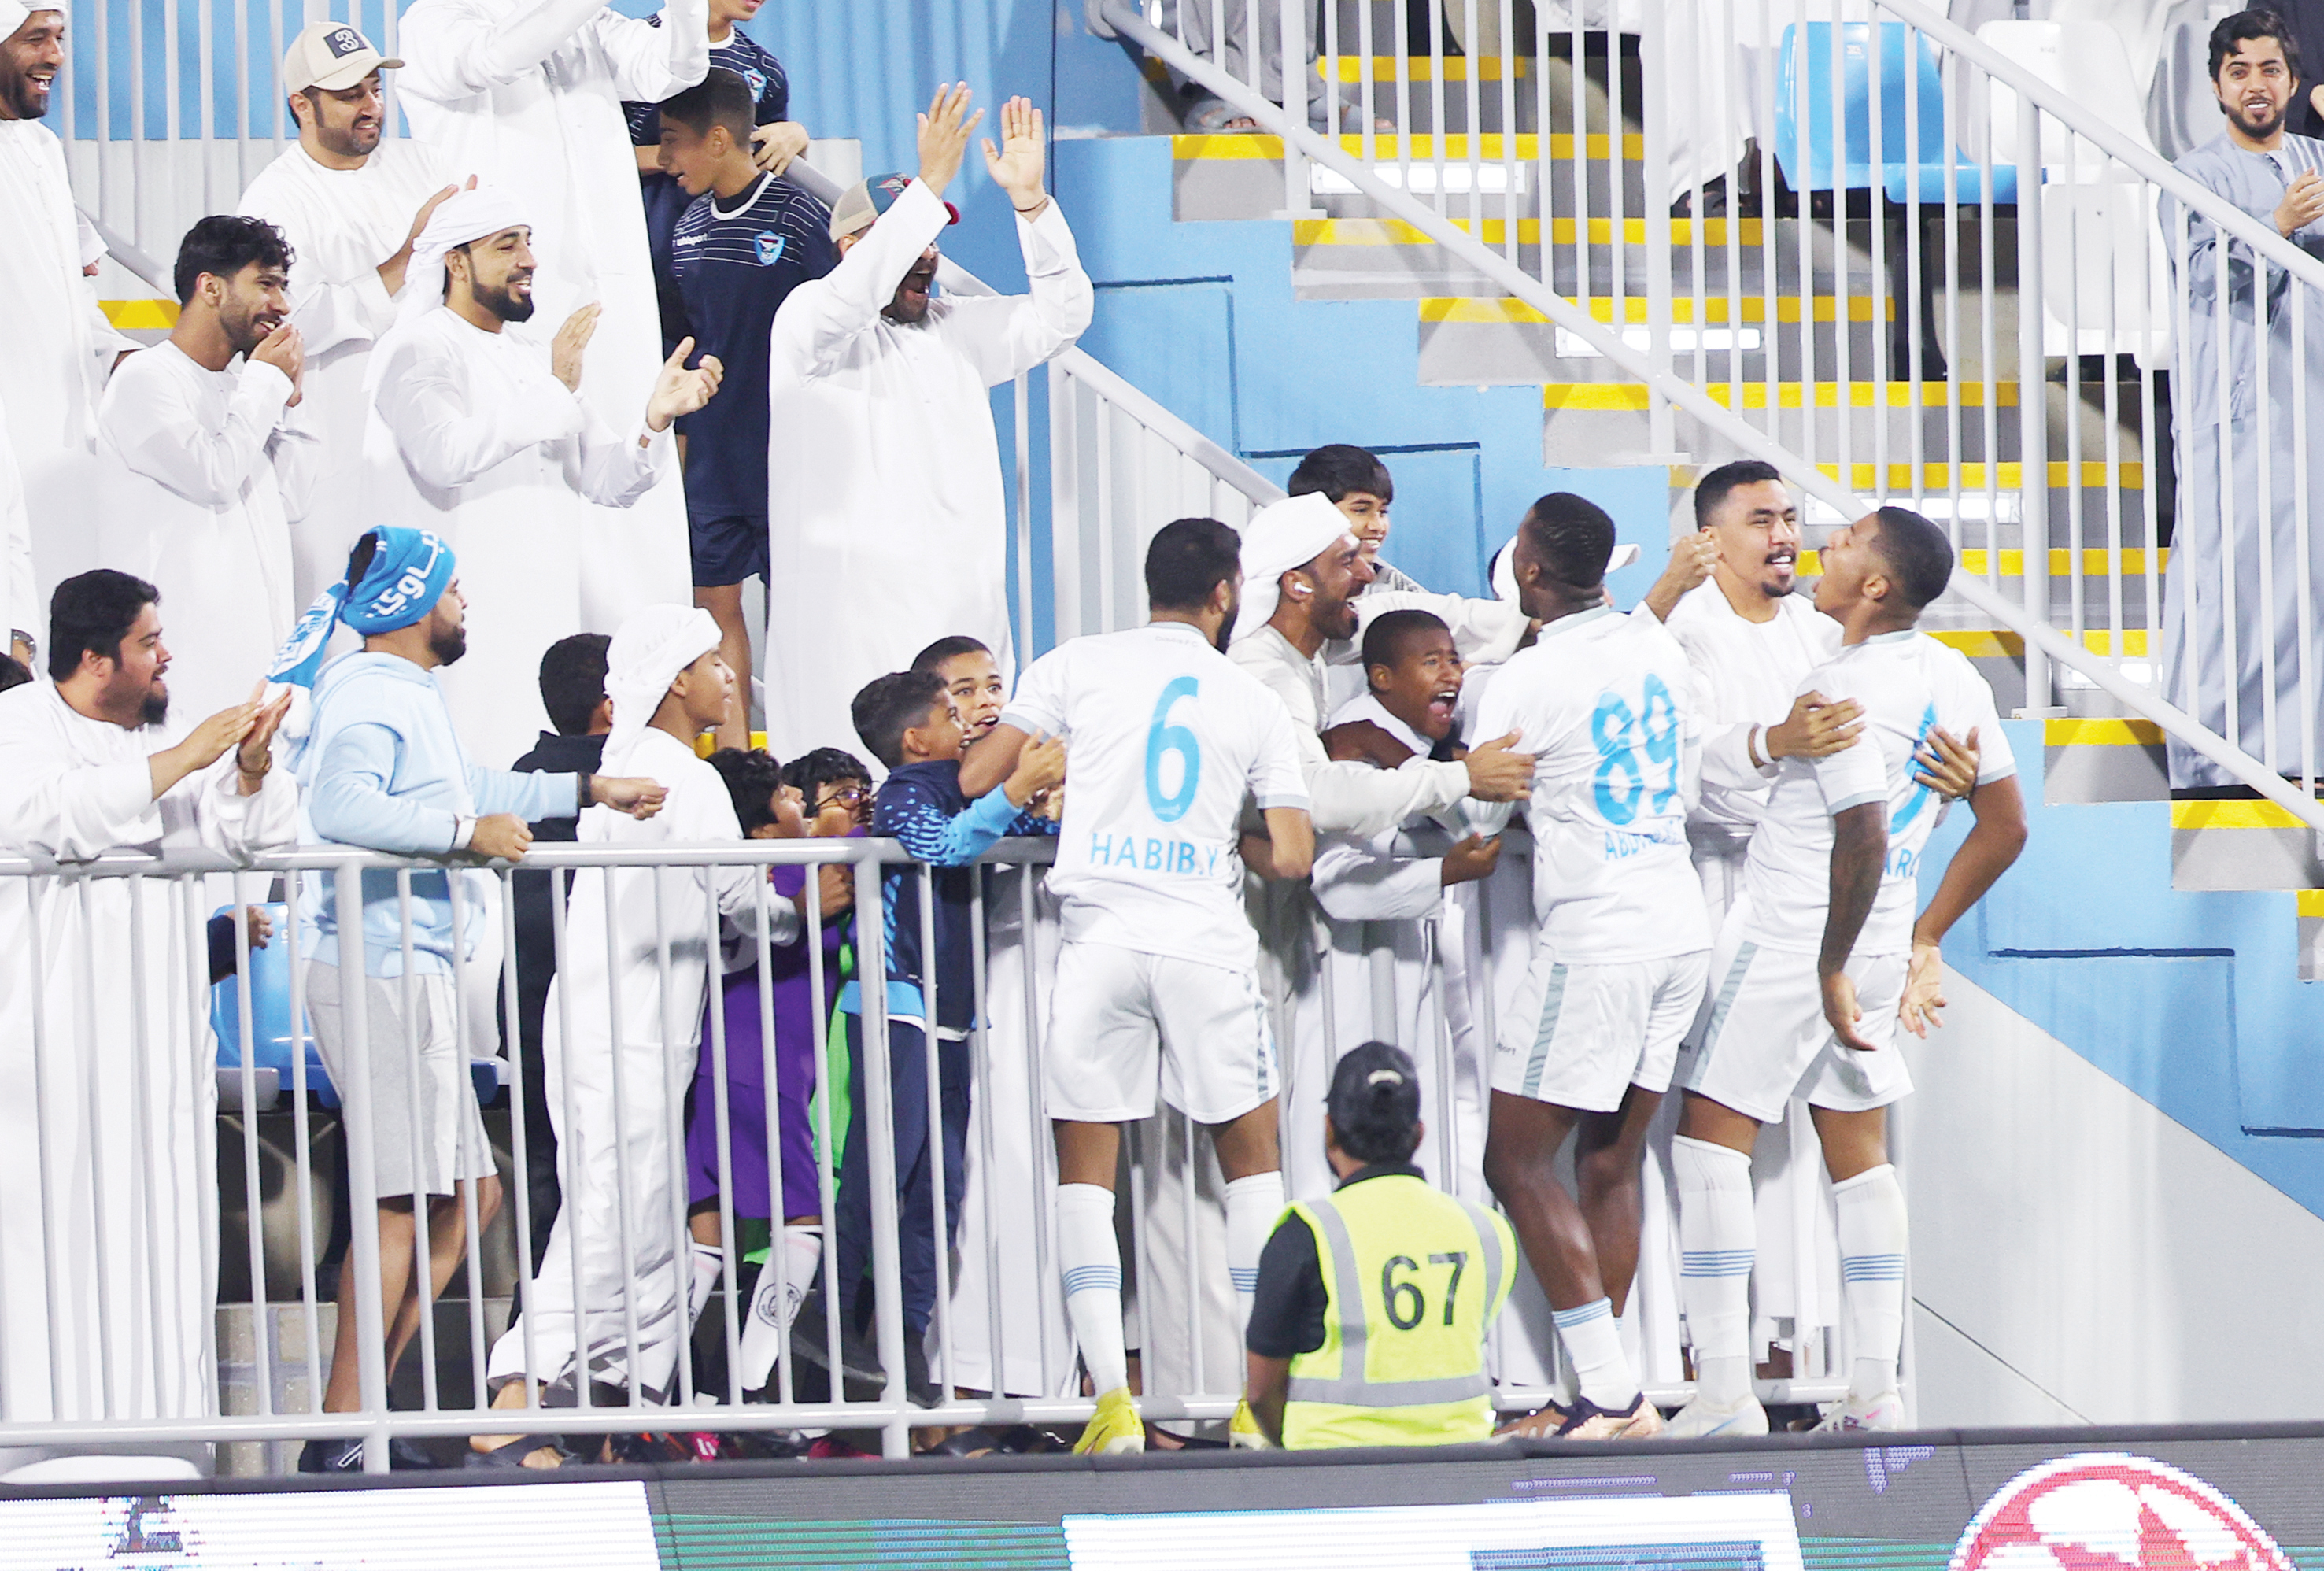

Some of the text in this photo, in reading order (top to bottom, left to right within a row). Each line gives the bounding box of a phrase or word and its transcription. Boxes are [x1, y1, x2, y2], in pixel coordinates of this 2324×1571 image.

[335, 29, 359, 52] 3
[1146, 675, 1201, 823] 6
[1591, 673, 1679, 825] 89
[1089, 833, 1218, 876] HABIB.Y
[1381, 1251, 1468, 1331] 67
